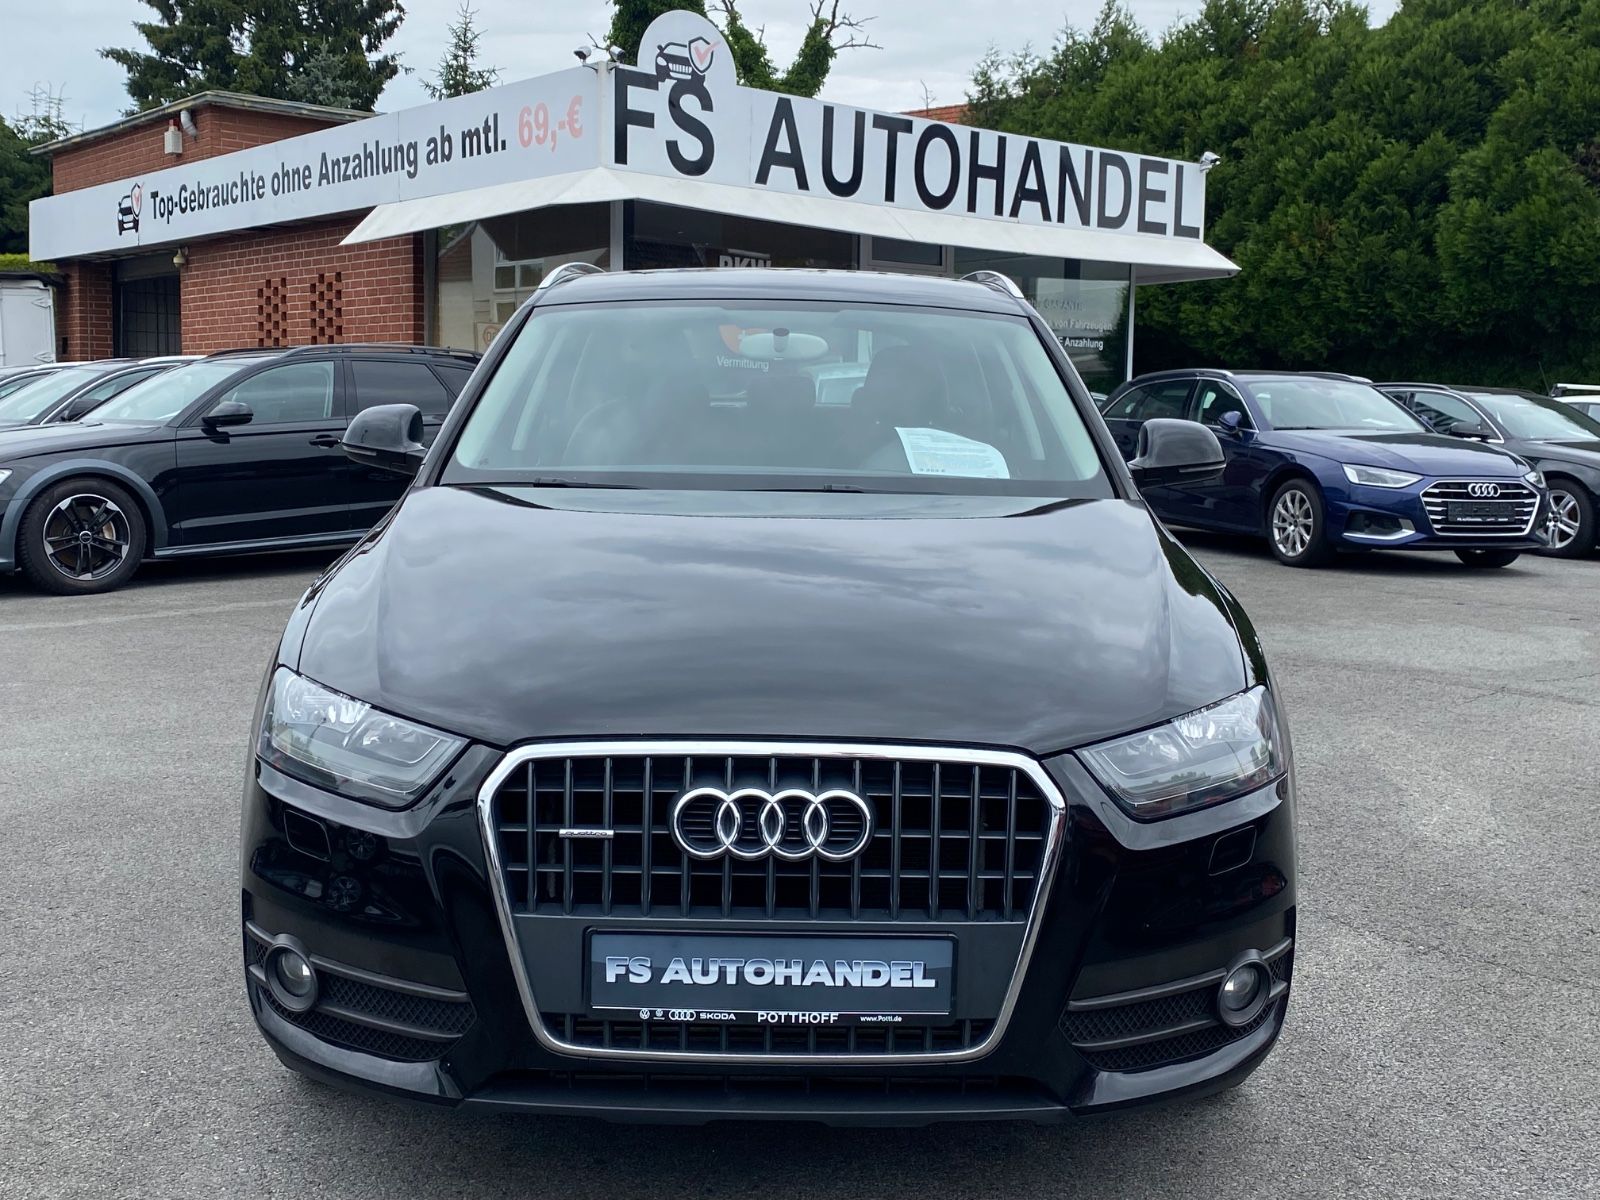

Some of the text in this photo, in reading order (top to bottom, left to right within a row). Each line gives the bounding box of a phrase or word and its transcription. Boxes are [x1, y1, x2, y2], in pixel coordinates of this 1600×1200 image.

[150, 95, 583, 224] Top-Gebrauchte ohne Anzahlung ab mtl. 69,-€
[614, 67, 1201, 238] FS AUTOHANDEL
[1054, 321, 1068, 329] von
[1069, 319, 1113, 332] Fahrzeugen
[1065, 337, 1104, 351] Anzahlung
[716, 355, 770, 373] Vermittlung
[605, 956, 937, 988] FS AUTOHANDEL
[757, 1011, 839, 1025] POTTHOFF
